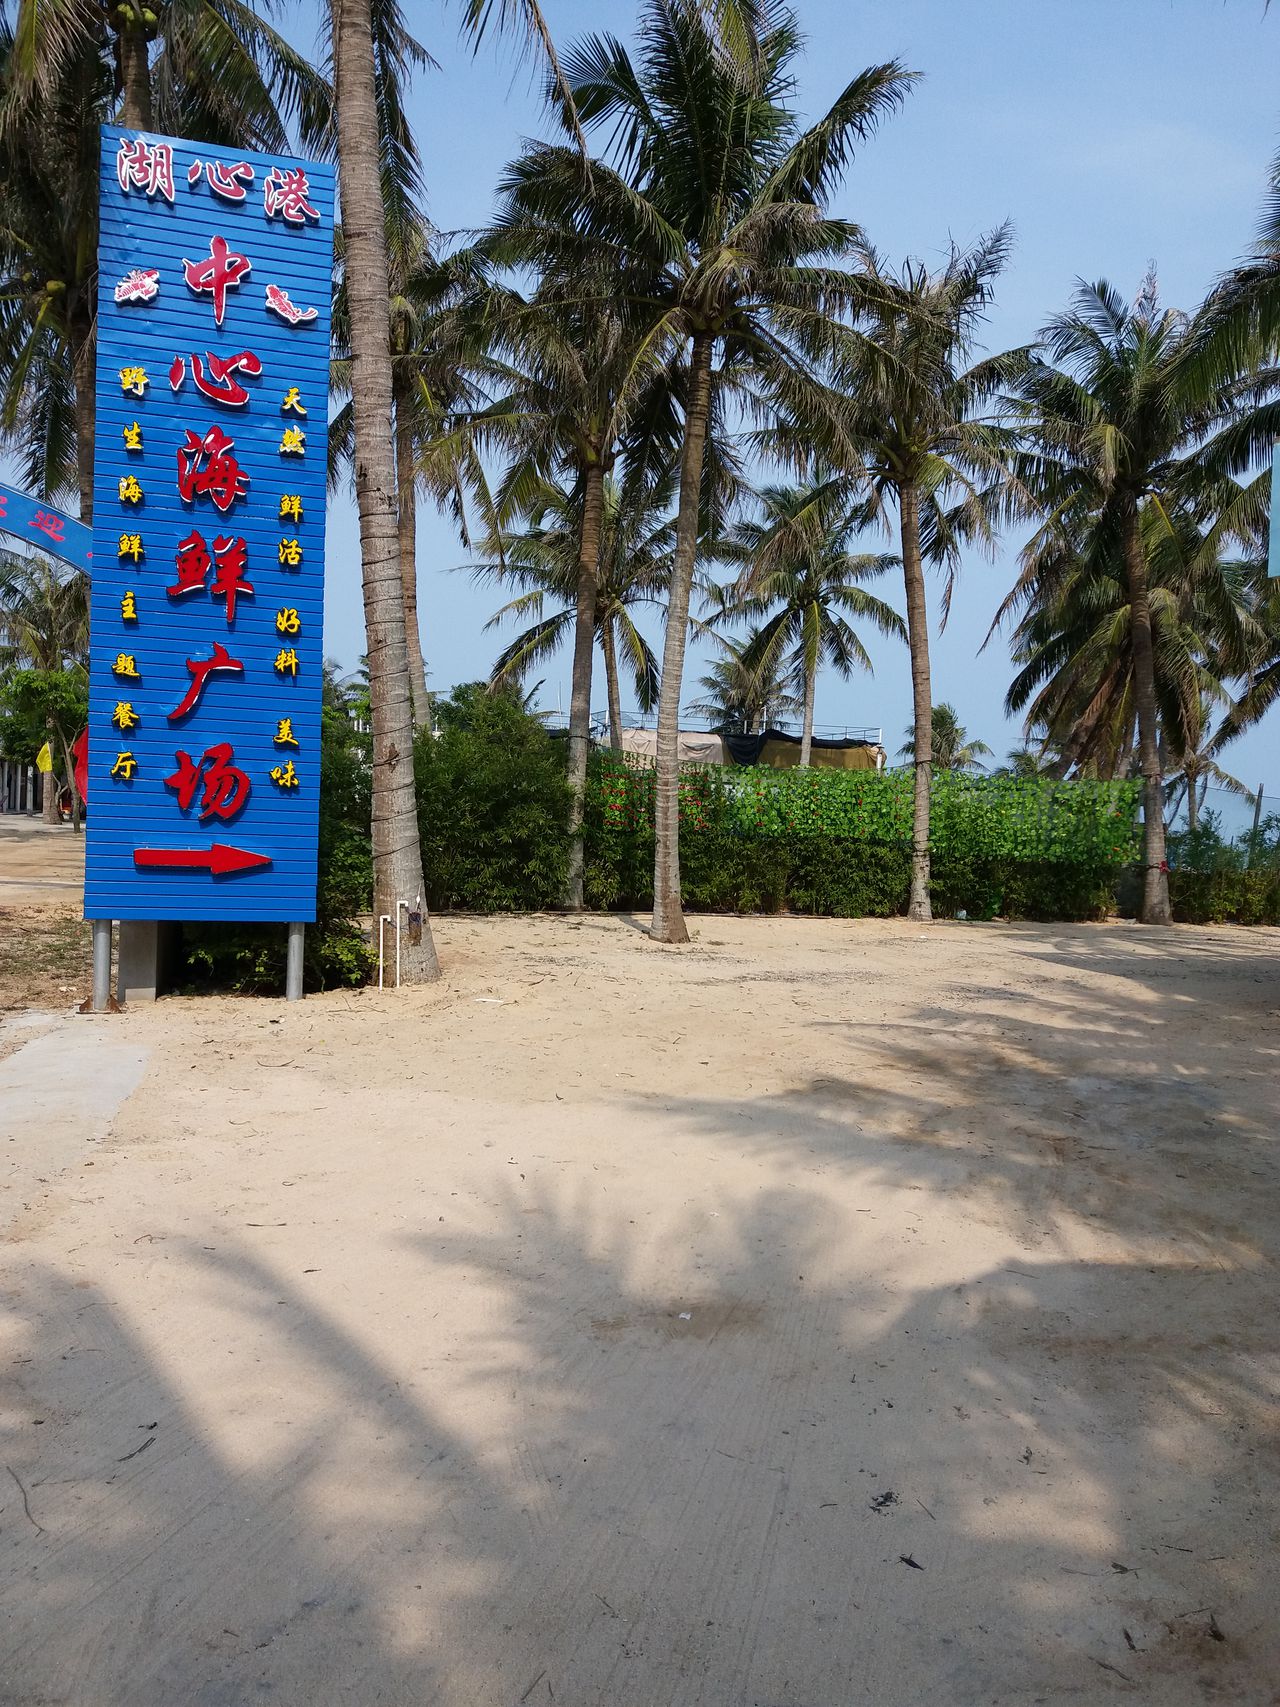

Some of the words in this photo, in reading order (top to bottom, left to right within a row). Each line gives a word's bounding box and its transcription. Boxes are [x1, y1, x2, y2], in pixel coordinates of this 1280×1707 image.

[115, 137, 321, 224] 湖心港
[110, 366, 150, 780] 野生海鲜主题餐厅
[164, 235, 264, 820] 中心海鲜广场
